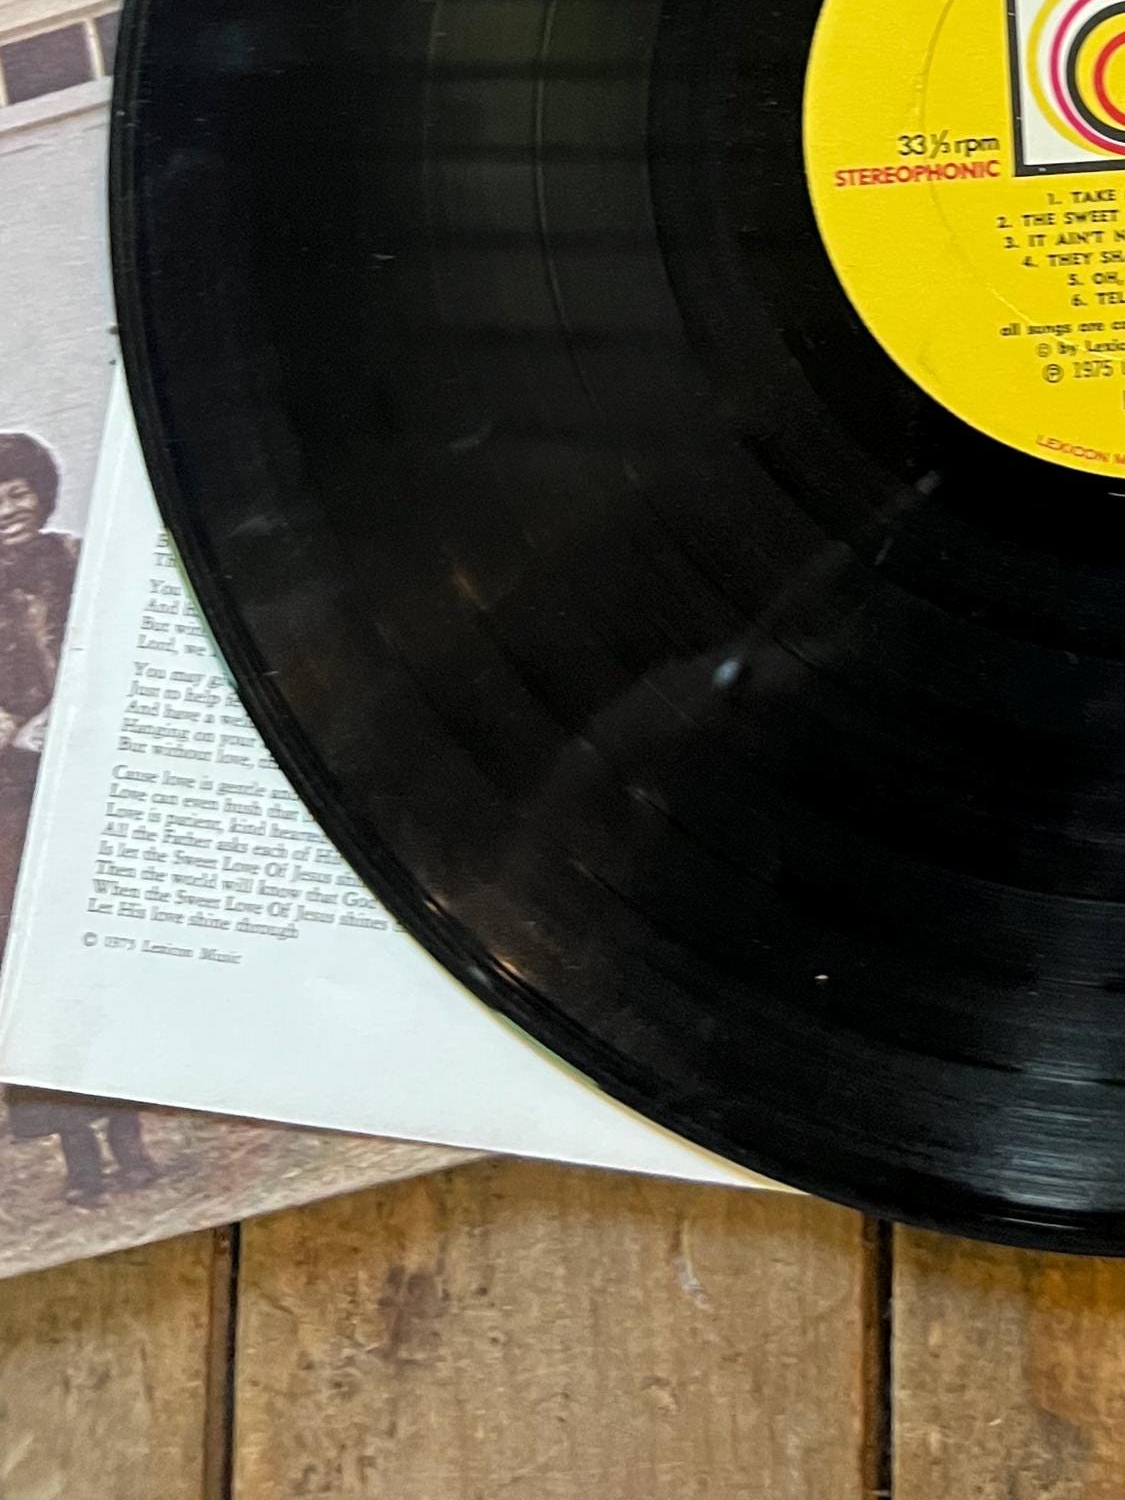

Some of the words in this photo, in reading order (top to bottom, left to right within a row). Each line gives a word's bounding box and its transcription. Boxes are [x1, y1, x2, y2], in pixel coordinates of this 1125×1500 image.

[835, 160, 1001, 187] STEREOPHONIC
[1071, 189, 1116, 203] TAKE
[1021, 213, 1056, 226] THE
[1064, 209, 1119, 224] SWEET
[1029, 234, 1046, 247] IT
[1046, 253, 1093, 266] THEY
[1092, 272, 1124, 286] OH,
[1000, 323, 1021, 336] all
[1028, 324, 1072, 336] songs
[1079, 323, 1105, 332] are
[1057, 341, 1077, 356] by
[1073, 360, 1114, 378] 1975
[1036, 434, 1111, 463] LEXICON
[133, 661, 167, 680] You
[169, 670, 206, 687] may
[112, 764, 159, 783] Cause
[162, 770, 196, 788] love
[108, 782, 148, 802] Love
[151, 793, 179, 805] can
[182, 797, 220, 810] even
[105, 802, 145, 821] Love
[101, 822, 129, 838] All
[131, 825, 158, 842] the
[162, 828, 213, 848] Father
[252, 843, 288, 859] each
[142, 846, 169, 863] the
[172, 849, 218, 870] Sweet
[222, 856, 261, 875] Love
[290, 865, 332, 884] Jesus
[95, 859, 137, 878] Then
[141, 866, 168, 882] the
[171, 873, 218, 889] world
[222, 877, 254, 893] will
[258, 879, 303, 899] know
[305, 887, 339, 905] that
[87, 897, 114, 915] Let
[117, 901, 146, 919] His
[150, 905, 185, 924] love
[187, 911, 231, 930] shine
[92, 878, 141, 898] When
[144, 886, 172, 903] the
[174, 889, 222, 909] Sweet
[224, 895, 264, 915] Love
[294, 904, 335, 924] Jesus
[338, 911, 389, 931] shines
